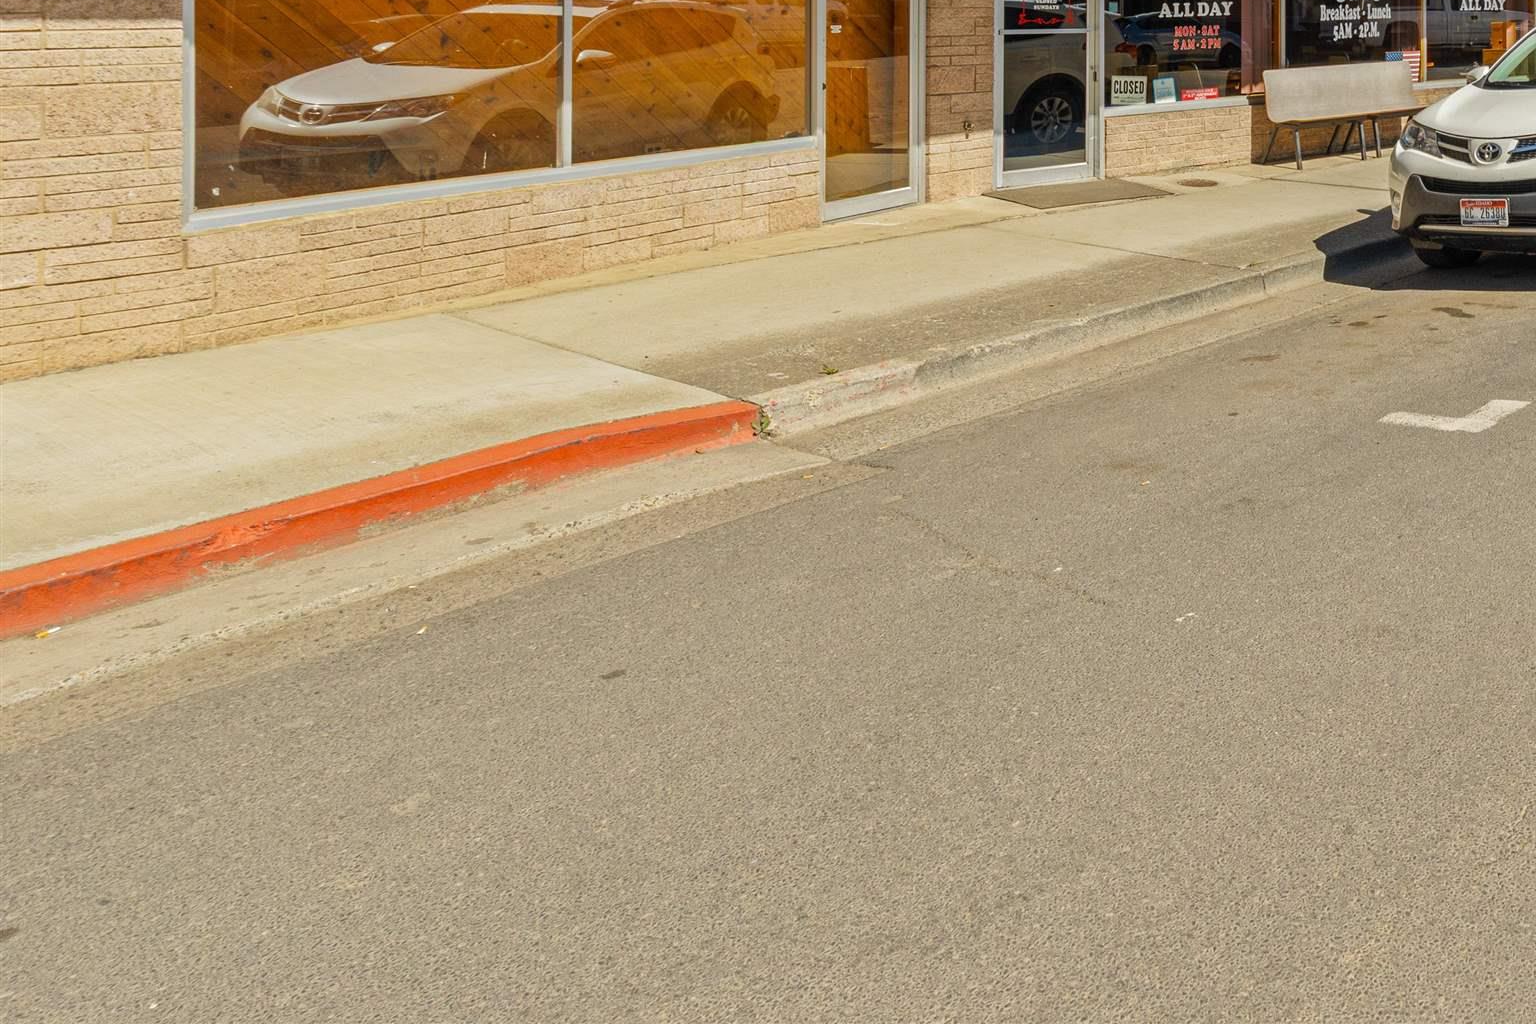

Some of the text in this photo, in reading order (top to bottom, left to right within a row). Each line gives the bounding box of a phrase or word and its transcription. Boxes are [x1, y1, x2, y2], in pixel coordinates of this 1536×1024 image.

[1158, 1, 1234, 18] ALL DAY
[1320, 3, 1392, 22] Breakfast Lunch
[1174, 24, 1220, 37] MON SAT
[1333, 22, 1353, 42] 5AM
[1173, 39, 1179, 50] 5
[1180, 38, 1196, 50] AM
[1207, 37, 1222, 49] PM
[1113, 80, 1145, 95] CLOSED
